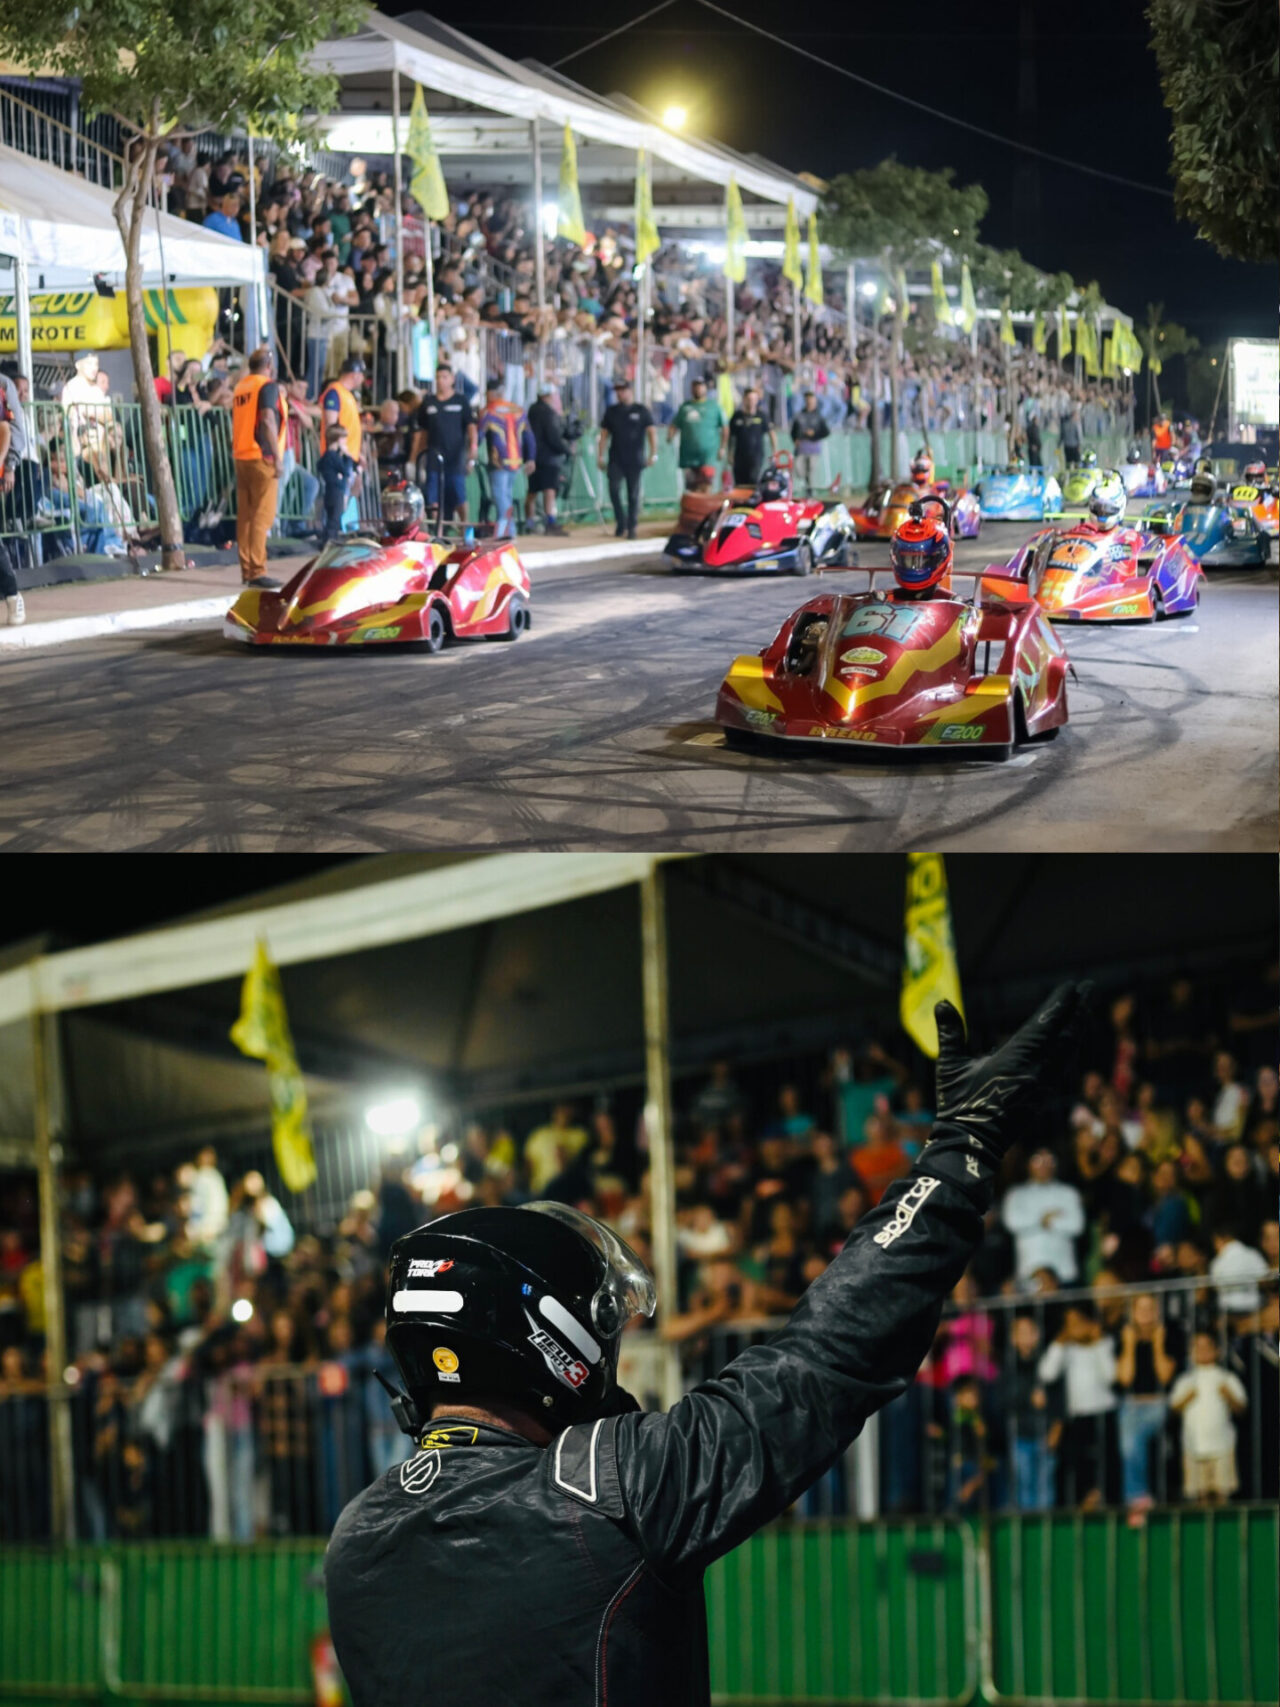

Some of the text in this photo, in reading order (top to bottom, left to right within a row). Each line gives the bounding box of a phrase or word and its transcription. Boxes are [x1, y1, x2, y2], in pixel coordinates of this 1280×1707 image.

[0, 325, 86, 341] MROTE
[842, 603, 920, 644] 61
[809, 726, 877, 741] BRENO
[941, 725, 983, 740] E200
[409, 1259, 434, 1269] PRO
[407, 1269, 435, 1278] TORK
